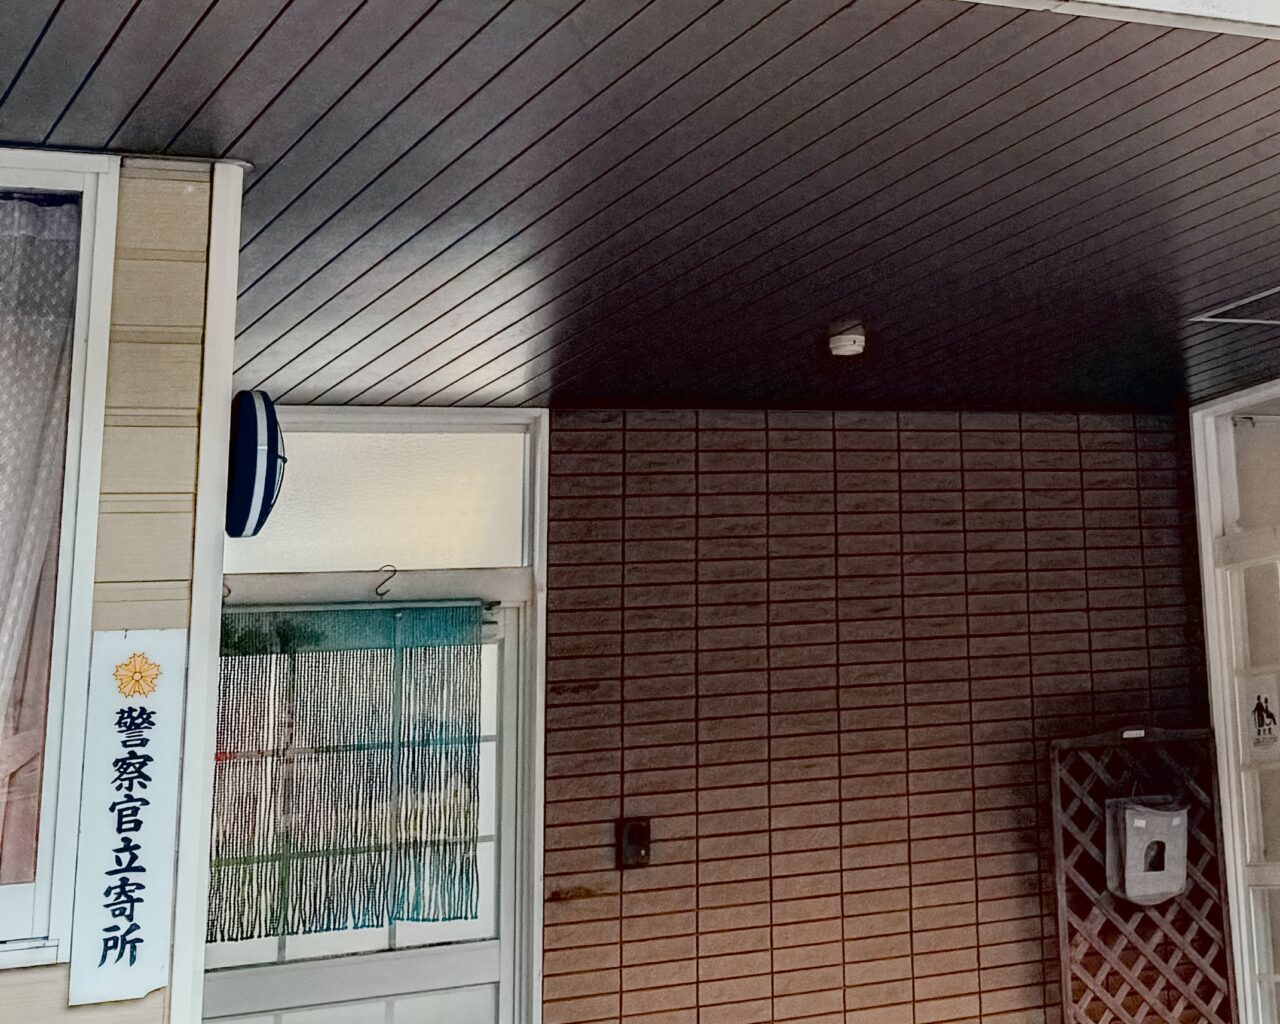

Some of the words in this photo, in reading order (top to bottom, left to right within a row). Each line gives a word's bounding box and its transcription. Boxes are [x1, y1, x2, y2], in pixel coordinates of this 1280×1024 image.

[98, 706, 156, 968] 警察官立寄所
